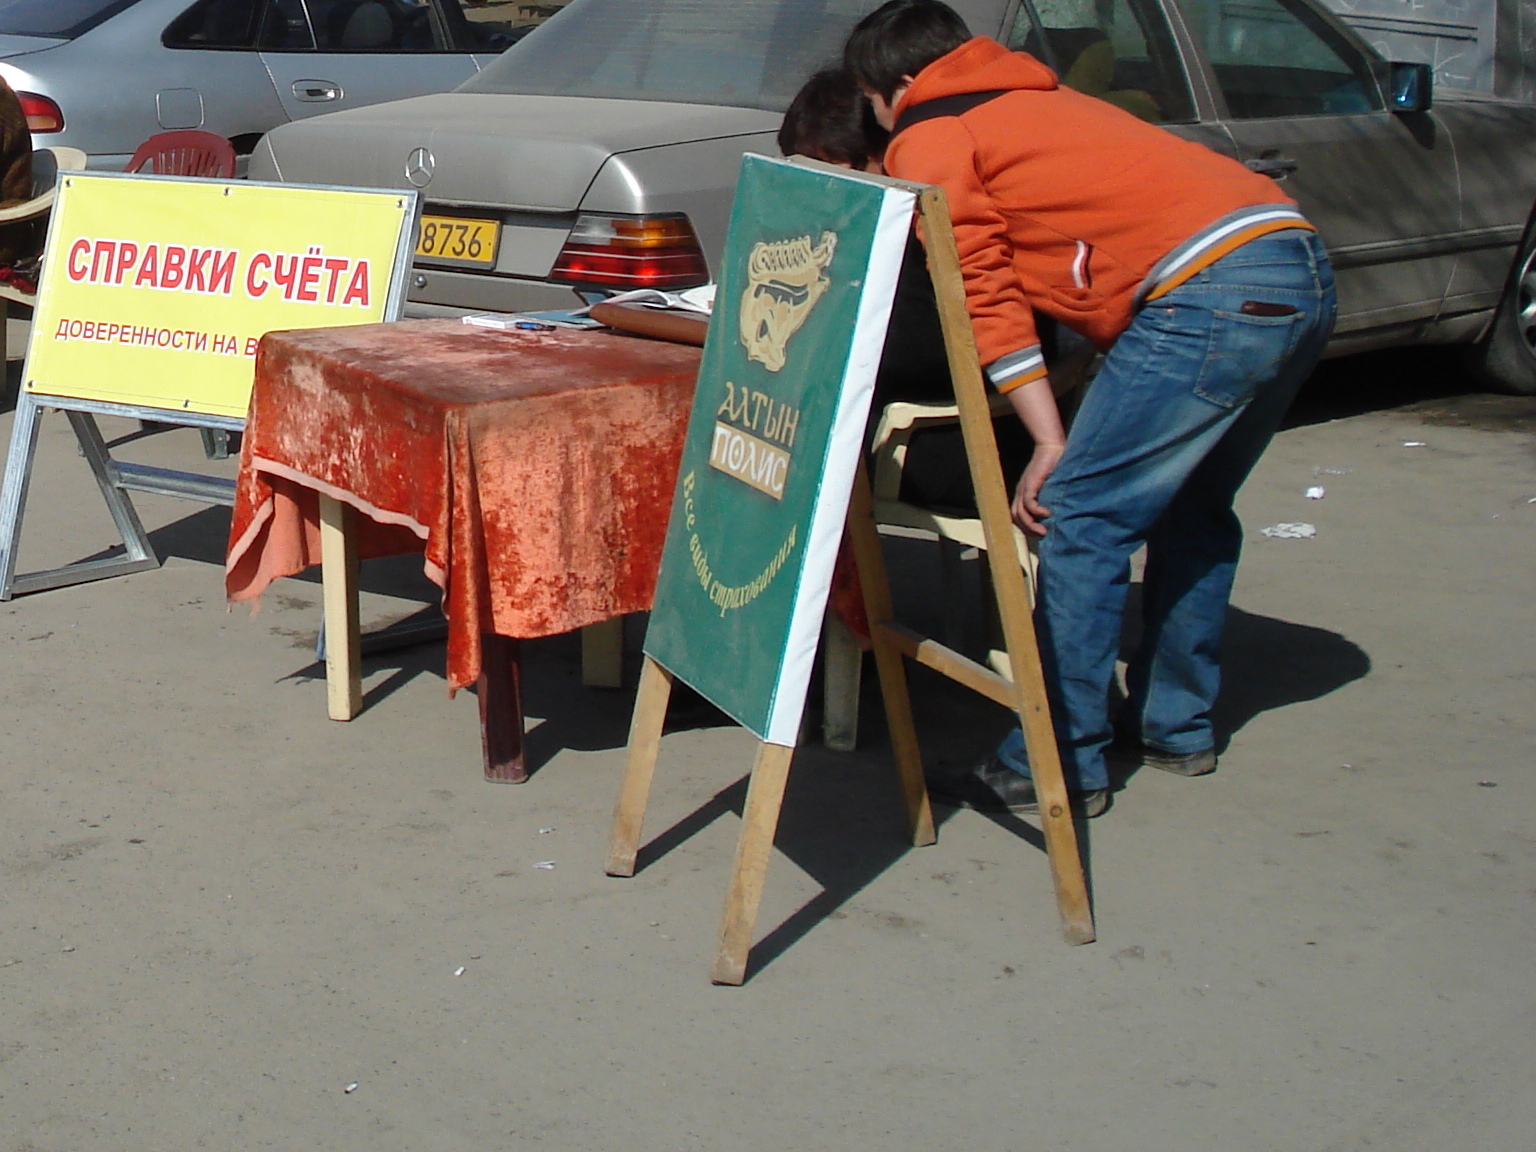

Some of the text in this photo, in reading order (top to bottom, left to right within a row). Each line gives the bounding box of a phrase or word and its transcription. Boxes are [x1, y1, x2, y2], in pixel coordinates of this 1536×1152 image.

[67, 239, 370, 306] СПРАВКИ СЧЁТА
[55, 318, 207, 352] ДОВЕРЕННОСТИ
[213, 334, 238, 355] НА
[718, 381, 800, 448] АЛТЫН
[712, 425, 788, 492] ПОЛИС
